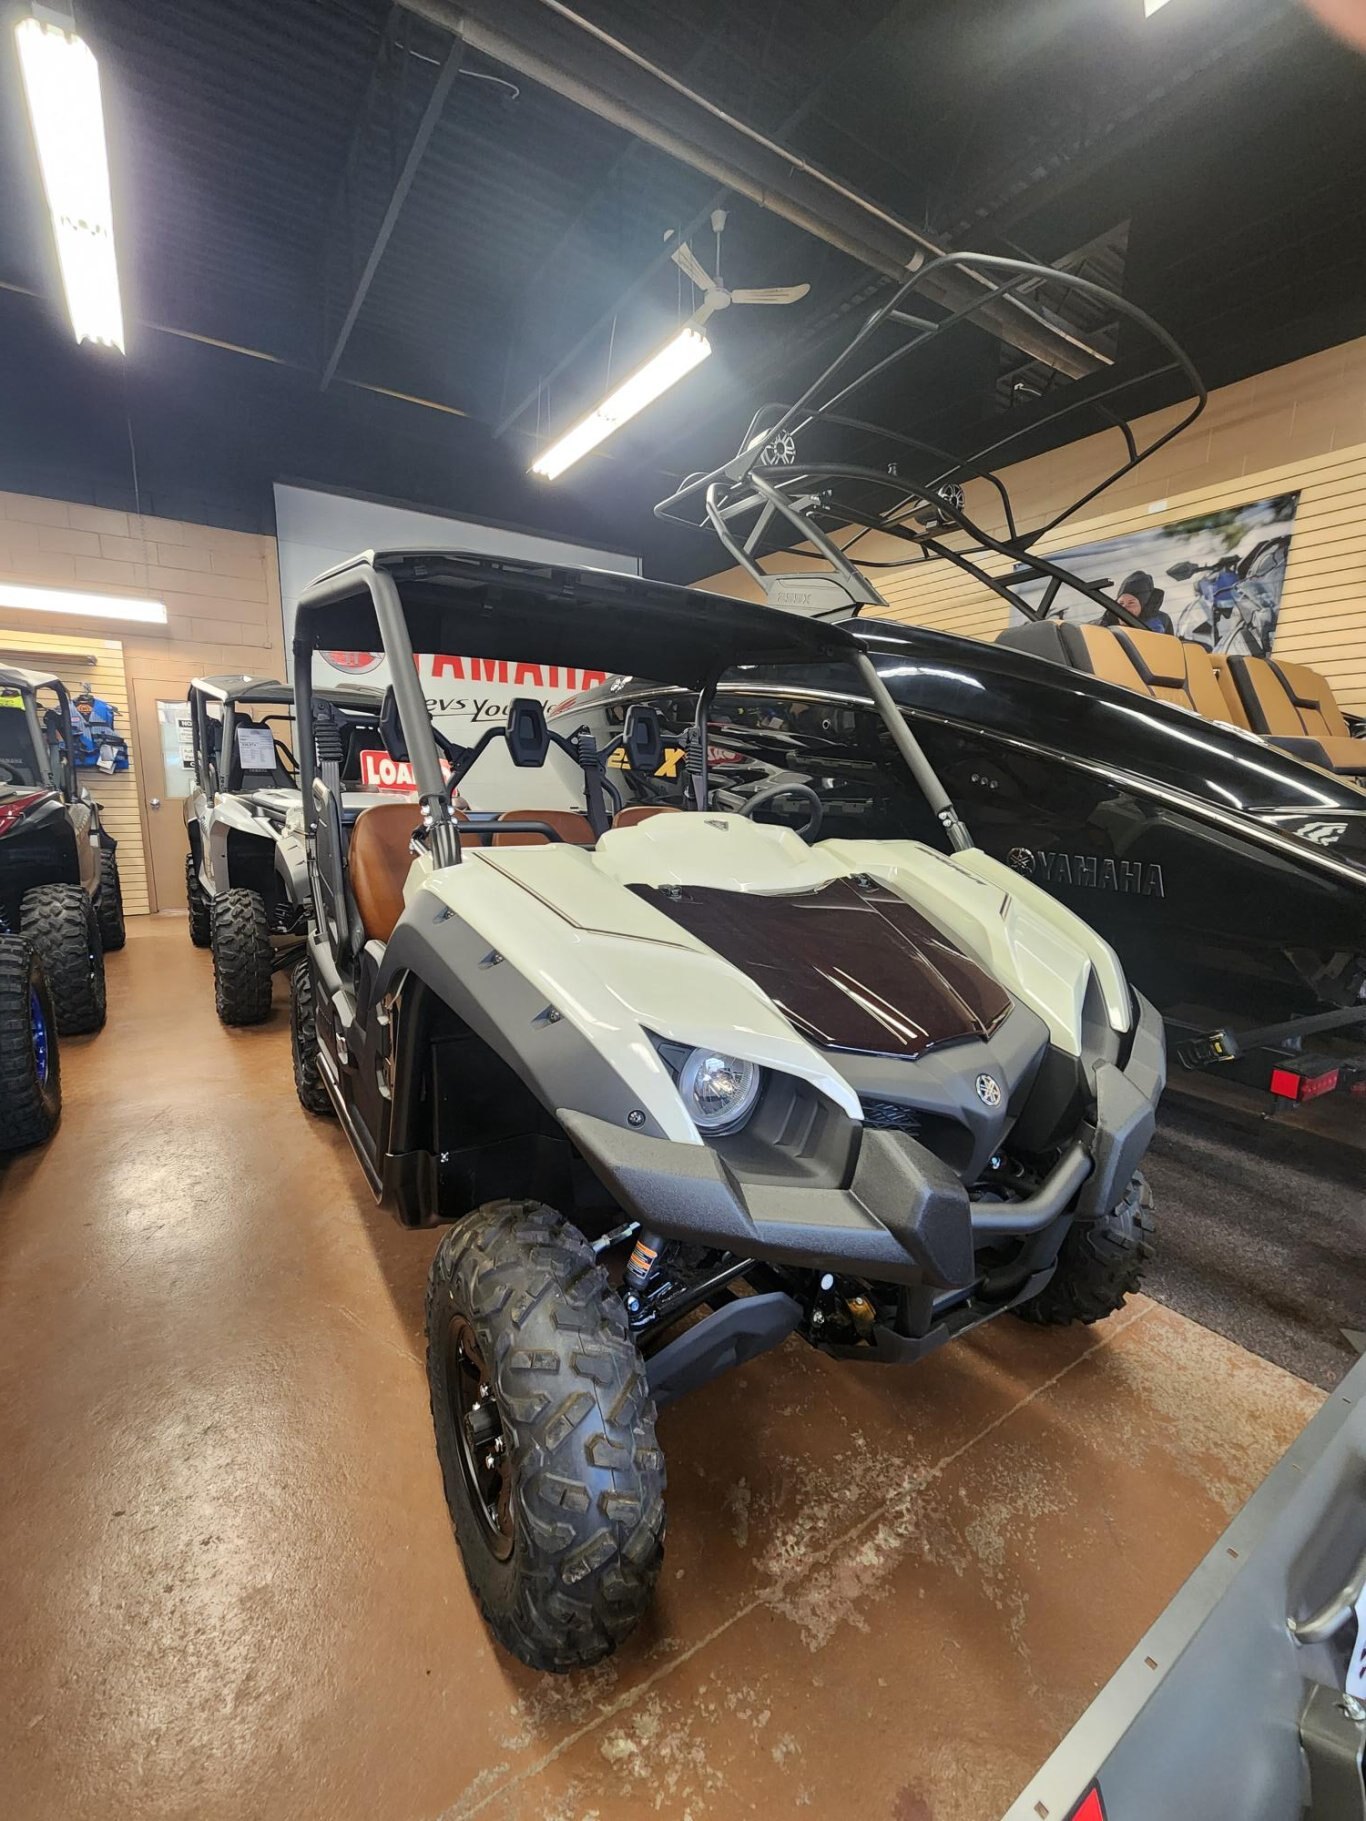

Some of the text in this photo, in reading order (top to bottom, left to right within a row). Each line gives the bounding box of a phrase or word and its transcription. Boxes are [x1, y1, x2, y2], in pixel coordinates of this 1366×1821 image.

[413, 653, 606, 691] AMAA
[424, 698, 508, 722] evs You
[1037, 850, 1165, 898] YAMAHA
